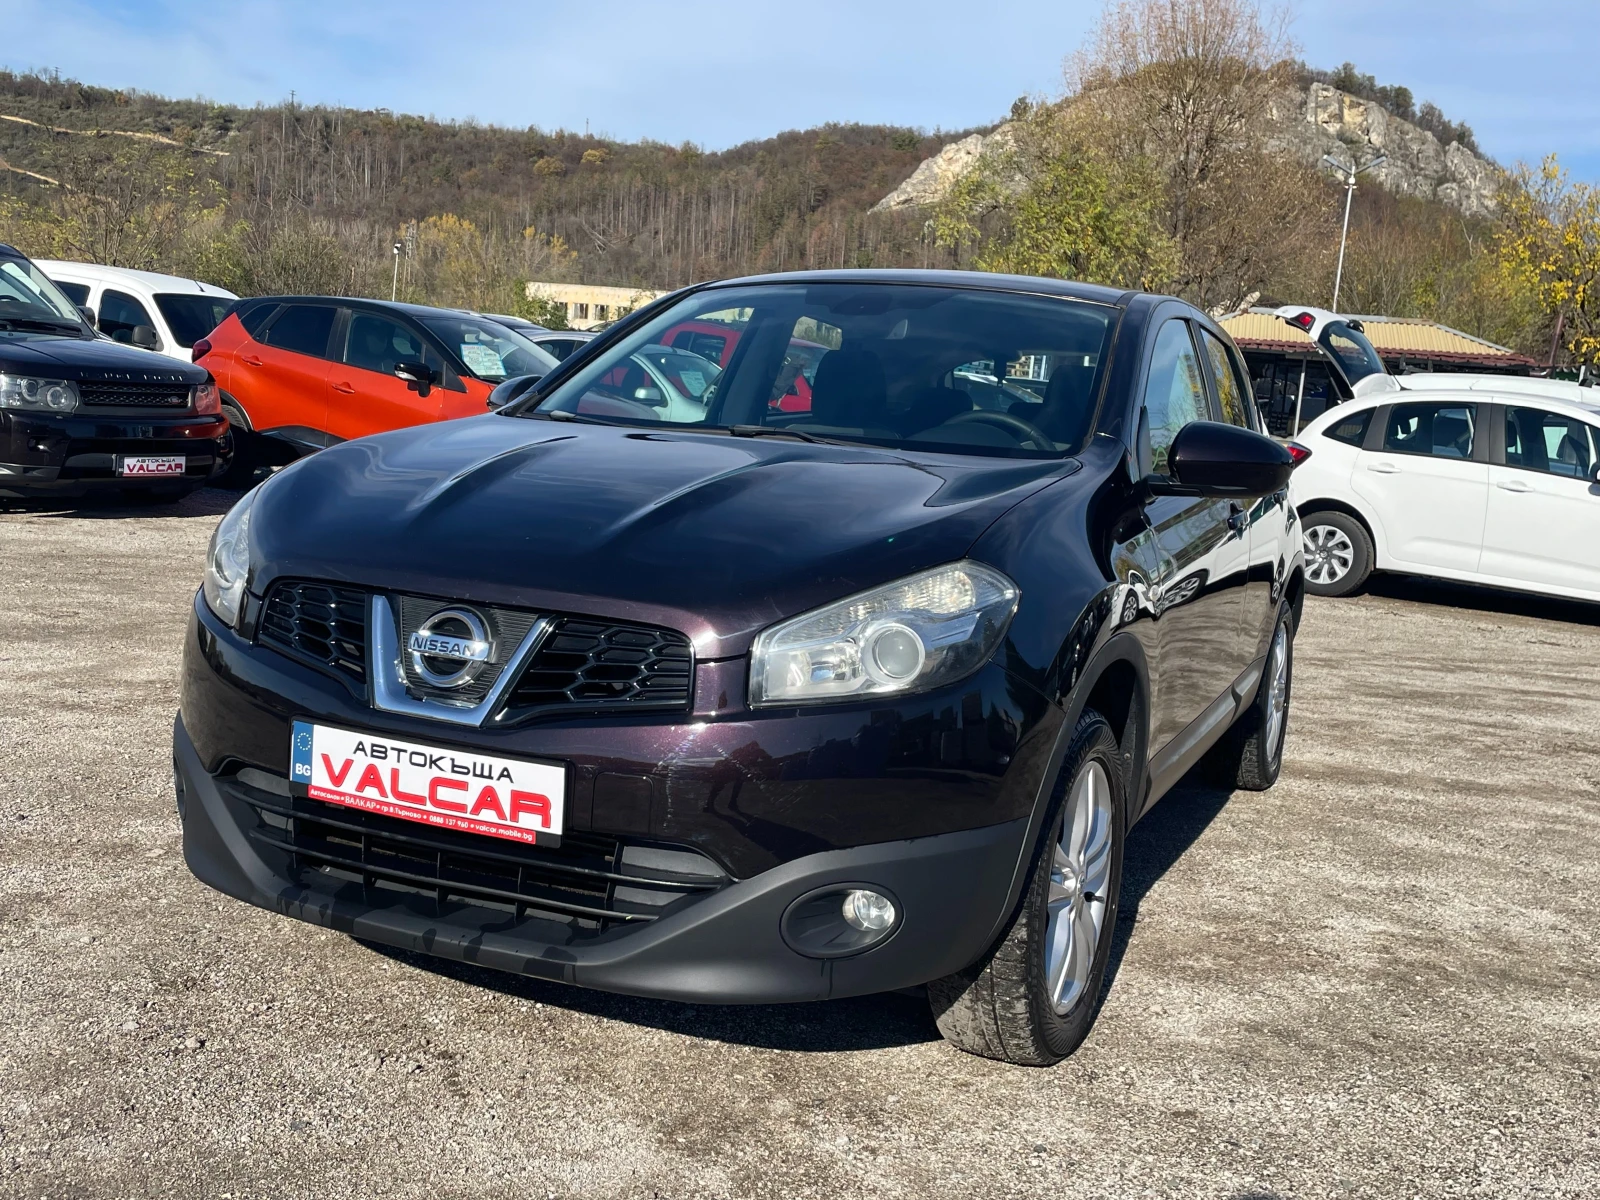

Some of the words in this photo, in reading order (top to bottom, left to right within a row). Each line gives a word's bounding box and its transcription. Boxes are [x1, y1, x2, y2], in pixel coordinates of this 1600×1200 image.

[126, 463, 183, 473] VALCAR
[295, 763, 311, 777] BG
[353, 740, 514, 784] АВТОКЪША
[320, 753, 552, 828] VALCAR
[345, 796, 377, 809] ВАЛКАР
[429, 815, 444, 824] 0888
[457, 821, 469, 829] 960
[475, 824, 533, 842] valcar.mobile.bg
